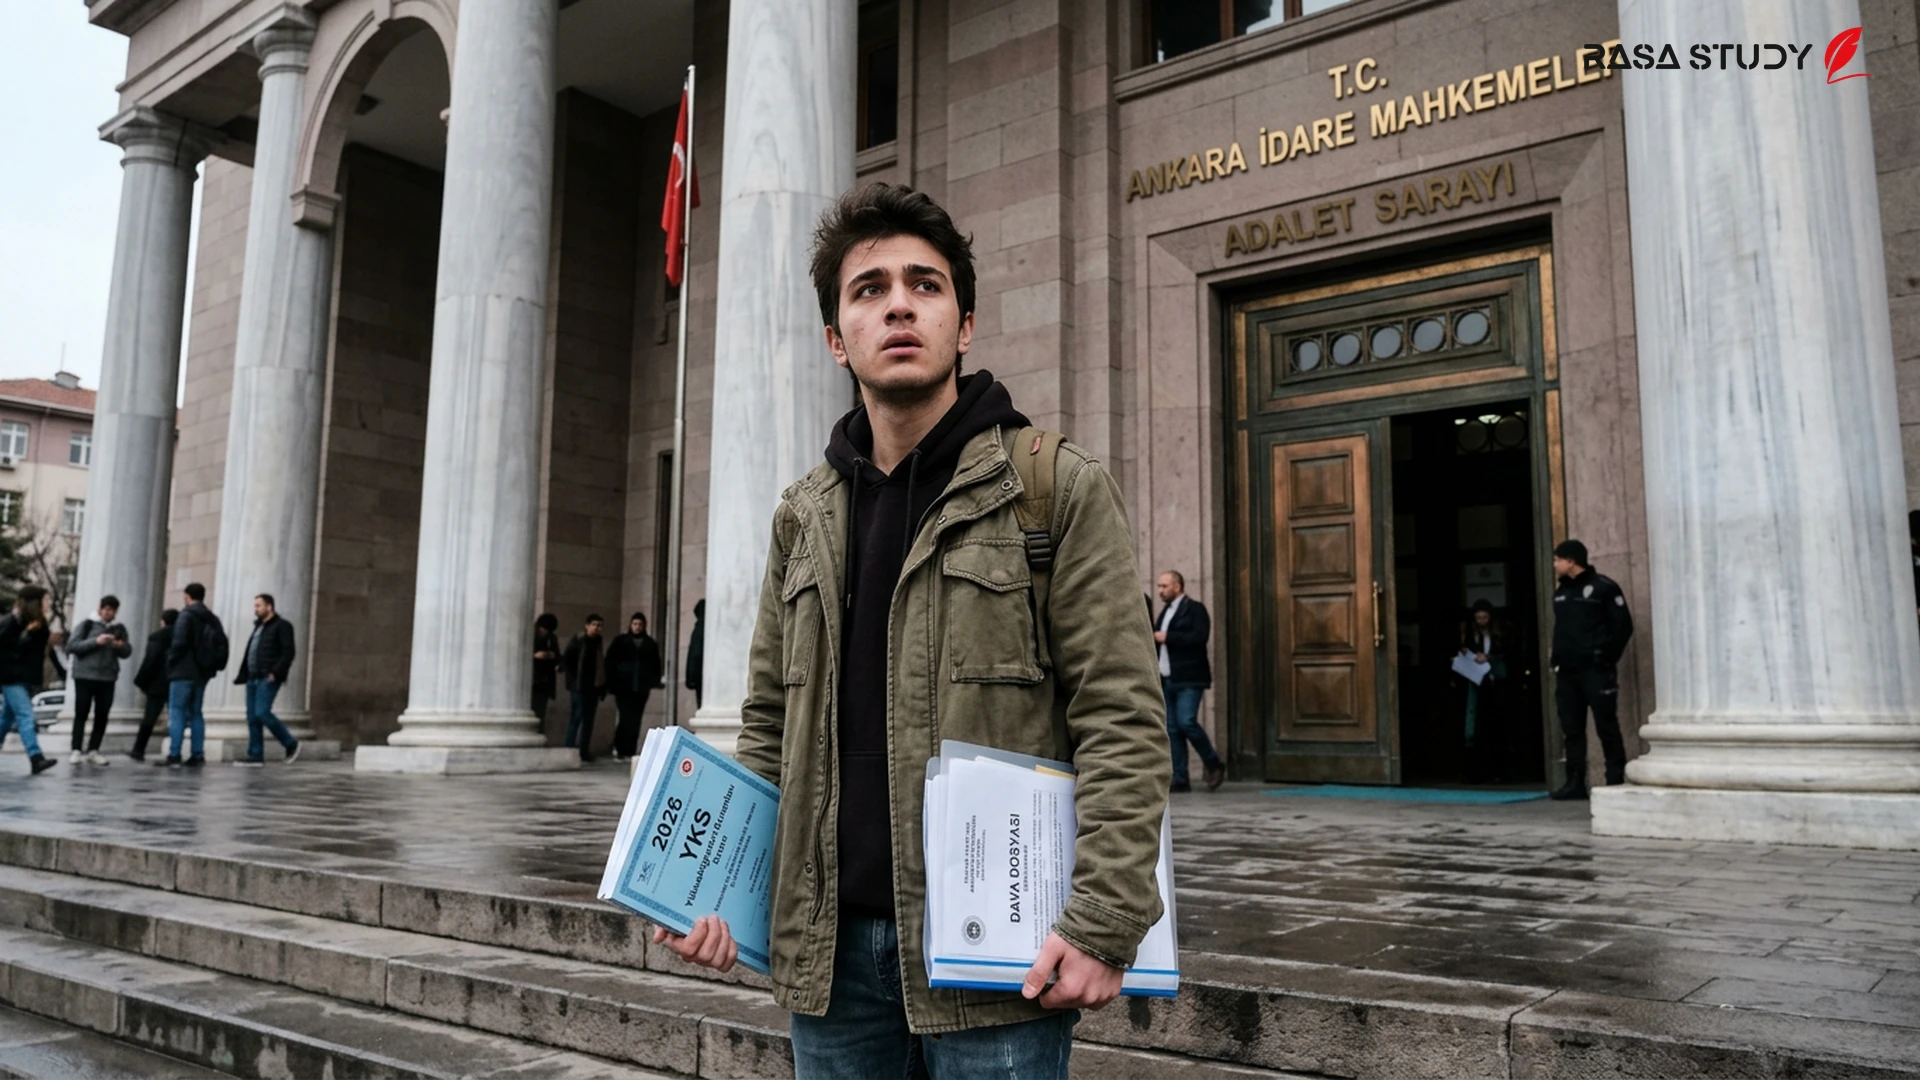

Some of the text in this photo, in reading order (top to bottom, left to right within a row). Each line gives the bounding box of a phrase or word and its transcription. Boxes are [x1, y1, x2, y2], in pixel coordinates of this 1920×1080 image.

[1328, 56, 1388, 99] T.C.
[1126, 142, 1248, 202] ANKARA
[1259, 111, 1356, 167] İDARE
[1224, 159, 1516, 258] ADALET SARAYI
[679, 808, 712, 860] YKS
[1009, 882, 1021, 923] DAVA
